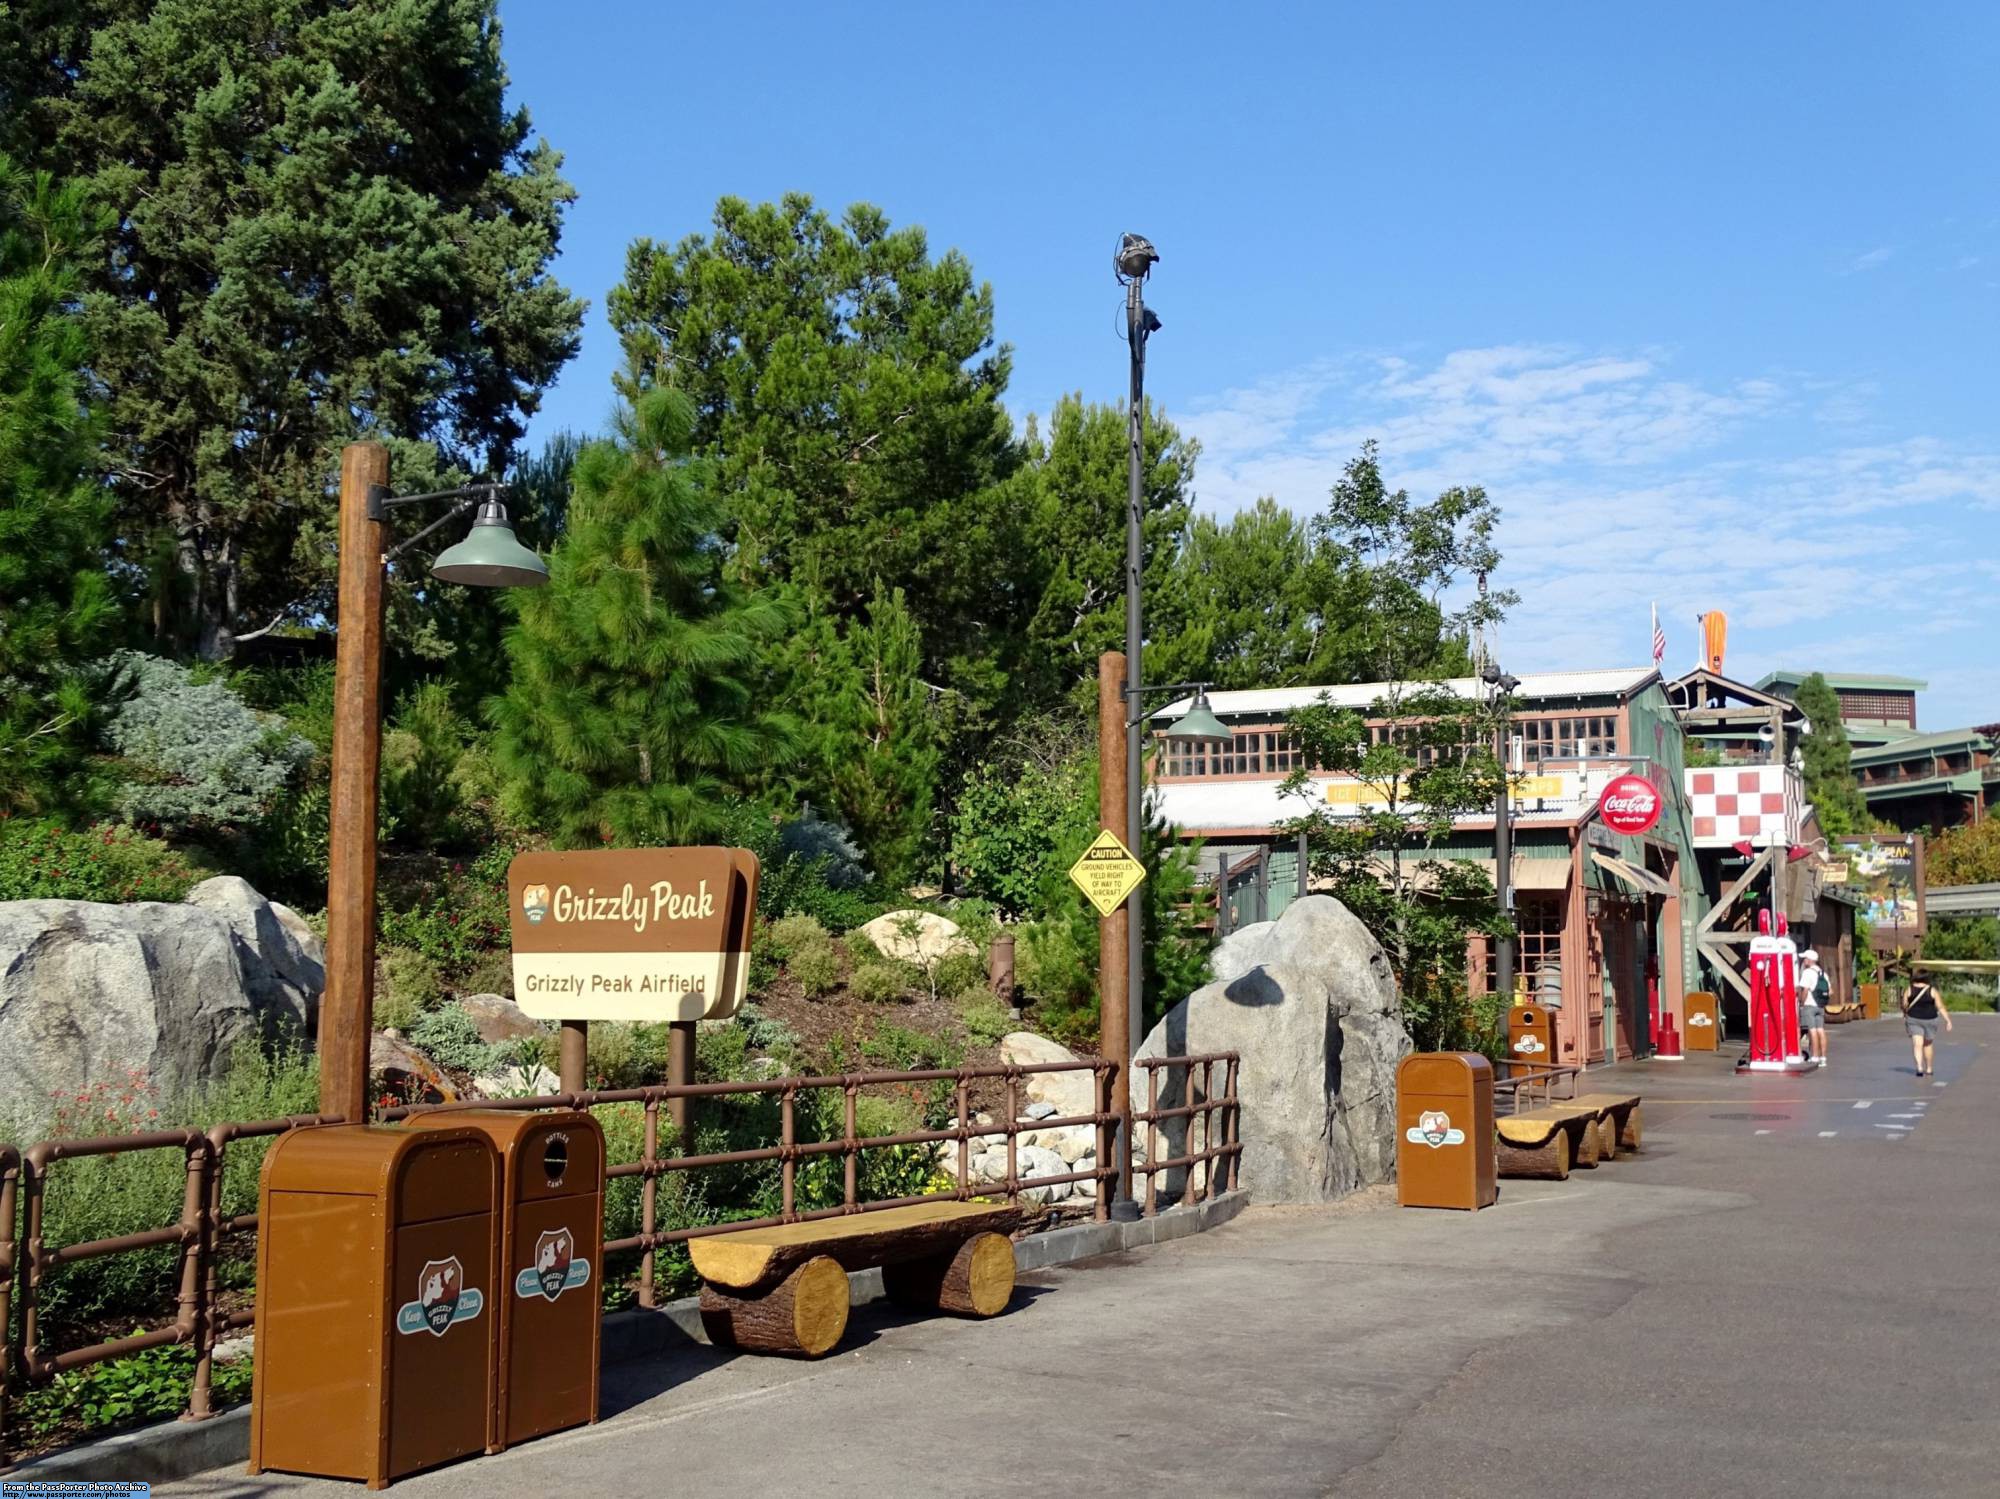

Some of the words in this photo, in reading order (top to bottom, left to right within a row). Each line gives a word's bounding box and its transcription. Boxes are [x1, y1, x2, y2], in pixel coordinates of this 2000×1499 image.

[1604, 794, 1656, 814] Coca-Cola
[1091, 849, 1122, 859] CAUTION
[1081, 863, 1105, 871] GROUND
[1106, 863, 1133, 871] VEHICLES
[1090, 872, 1106, 880] YIELD
[1107, 872, 1124, 880] RIGHT
[1093, 889, 1121, 897] AIRCRAFT
[553, 883, 648, 933] Grizzly
[650, 880, 715, 921] Peak
[526, 975, 585, 997] Grizzly
[591, 975, 633, 993] Peak
[640, 974, 705, 993] Airfield
[545, 1132, 569, 1145] BOTTLES
[542, 1272, 565, 1284] GRIZZLY
[546, 1280, 560, 1291] PEAK
[405, 1310, 421, 1323] Keep
[428, 1305, 453, 1318] GRIZZLY
[432, 1314, 448, 1326] PEAK
